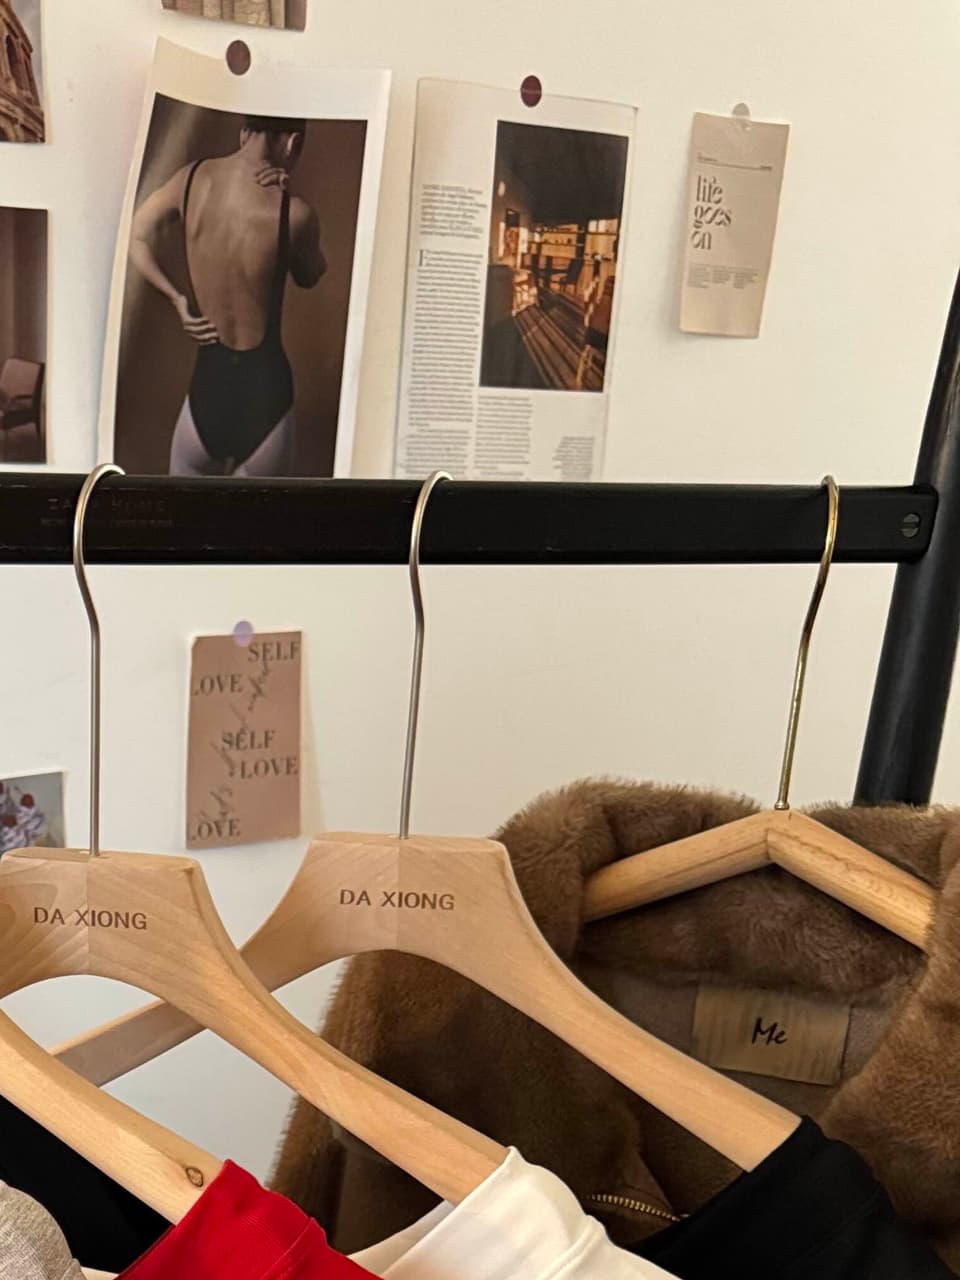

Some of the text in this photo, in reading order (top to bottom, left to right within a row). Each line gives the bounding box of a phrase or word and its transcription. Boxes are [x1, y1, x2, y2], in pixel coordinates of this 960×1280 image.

[693, 206, 732, 229] goes
[691, 230, 712, 250] on
[248, 640, 301, 663] SELF
[222, 729, 276, 752] SELF
[240, 756, 300, 780] LOVE
[340, 889, 455, 911] DA XIONG
[34, 907, 148, 930] DA XIONG
